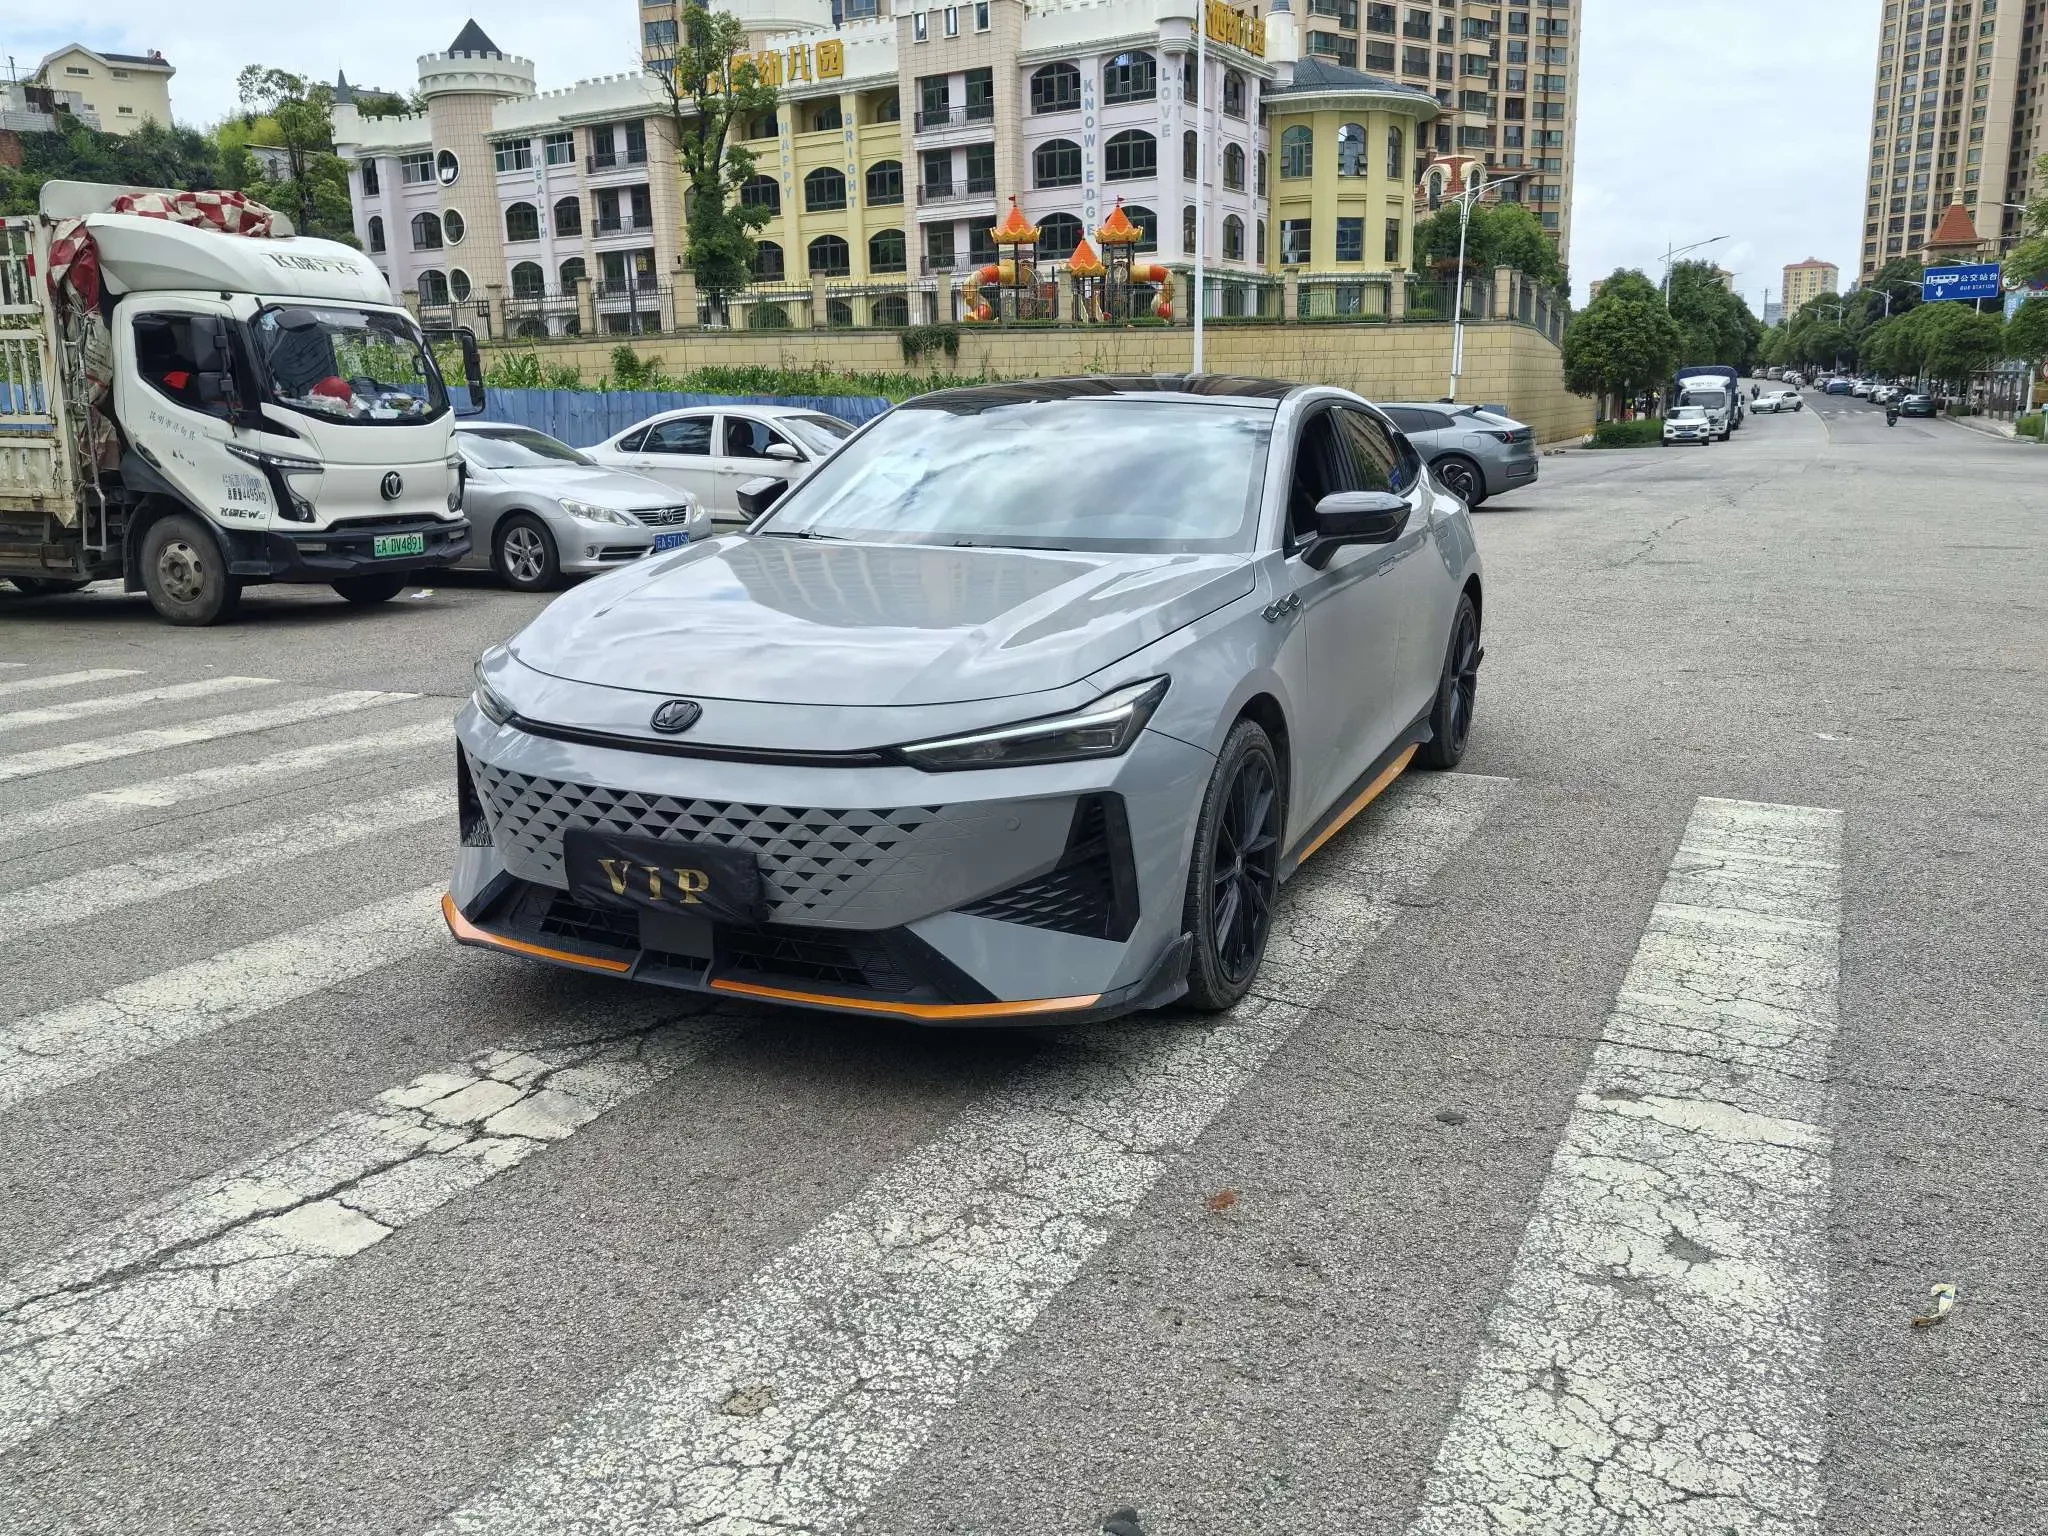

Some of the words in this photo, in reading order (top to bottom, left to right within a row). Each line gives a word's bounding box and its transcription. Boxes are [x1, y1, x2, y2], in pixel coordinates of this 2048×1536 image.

[1160, 67, 1172, 139] LOVE
[1176, 67, 1184, 121] ART
[780, 121, 792, 199] HAPPY
[844, 112, 857, 208] BRIGHT
[1083, 78, 1096, 236] KNOWLEDGE
[534, 155, 548, 239] HEALTH
[1960, 272, 1998, 282] 公交站台
[597, 859, 710, 904] VIP
